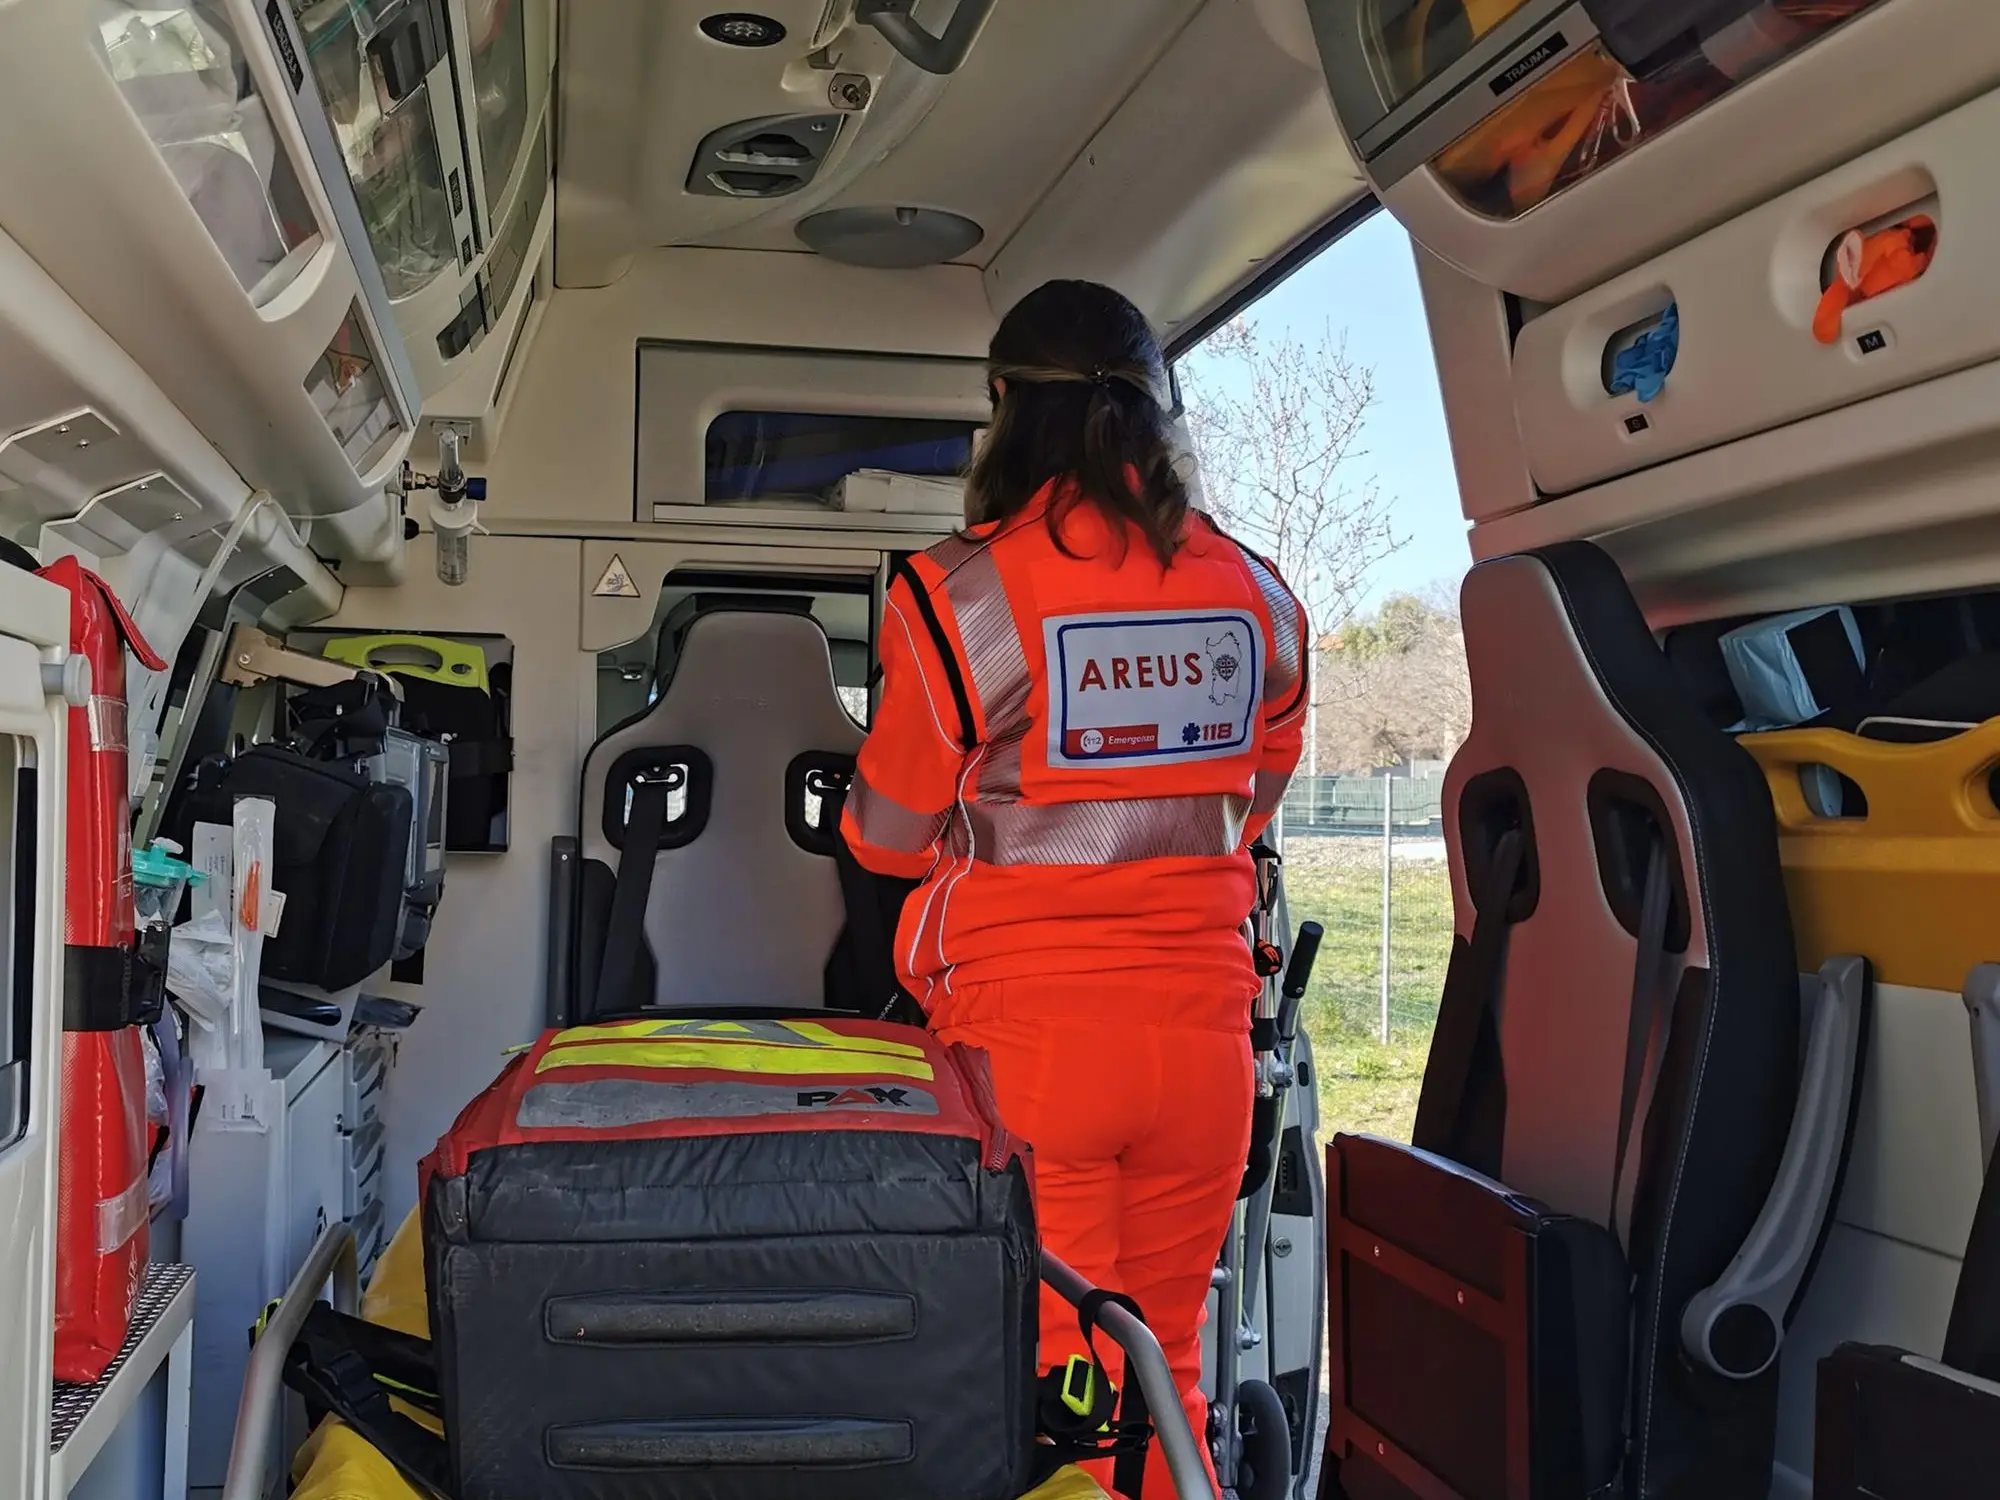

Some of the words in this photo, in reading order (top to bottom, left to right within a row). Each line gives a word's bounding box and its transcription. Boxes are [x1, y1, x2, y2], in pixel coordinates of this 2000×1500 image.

[1504, 47, 1552, 83] TRAUMA
[1864, 335, 1879, 350] M
[1079, 652, 1203, 692] AREUS
[1201, 722, 1233, 742] 118
[796, 1087, 911, 1107] PAX
